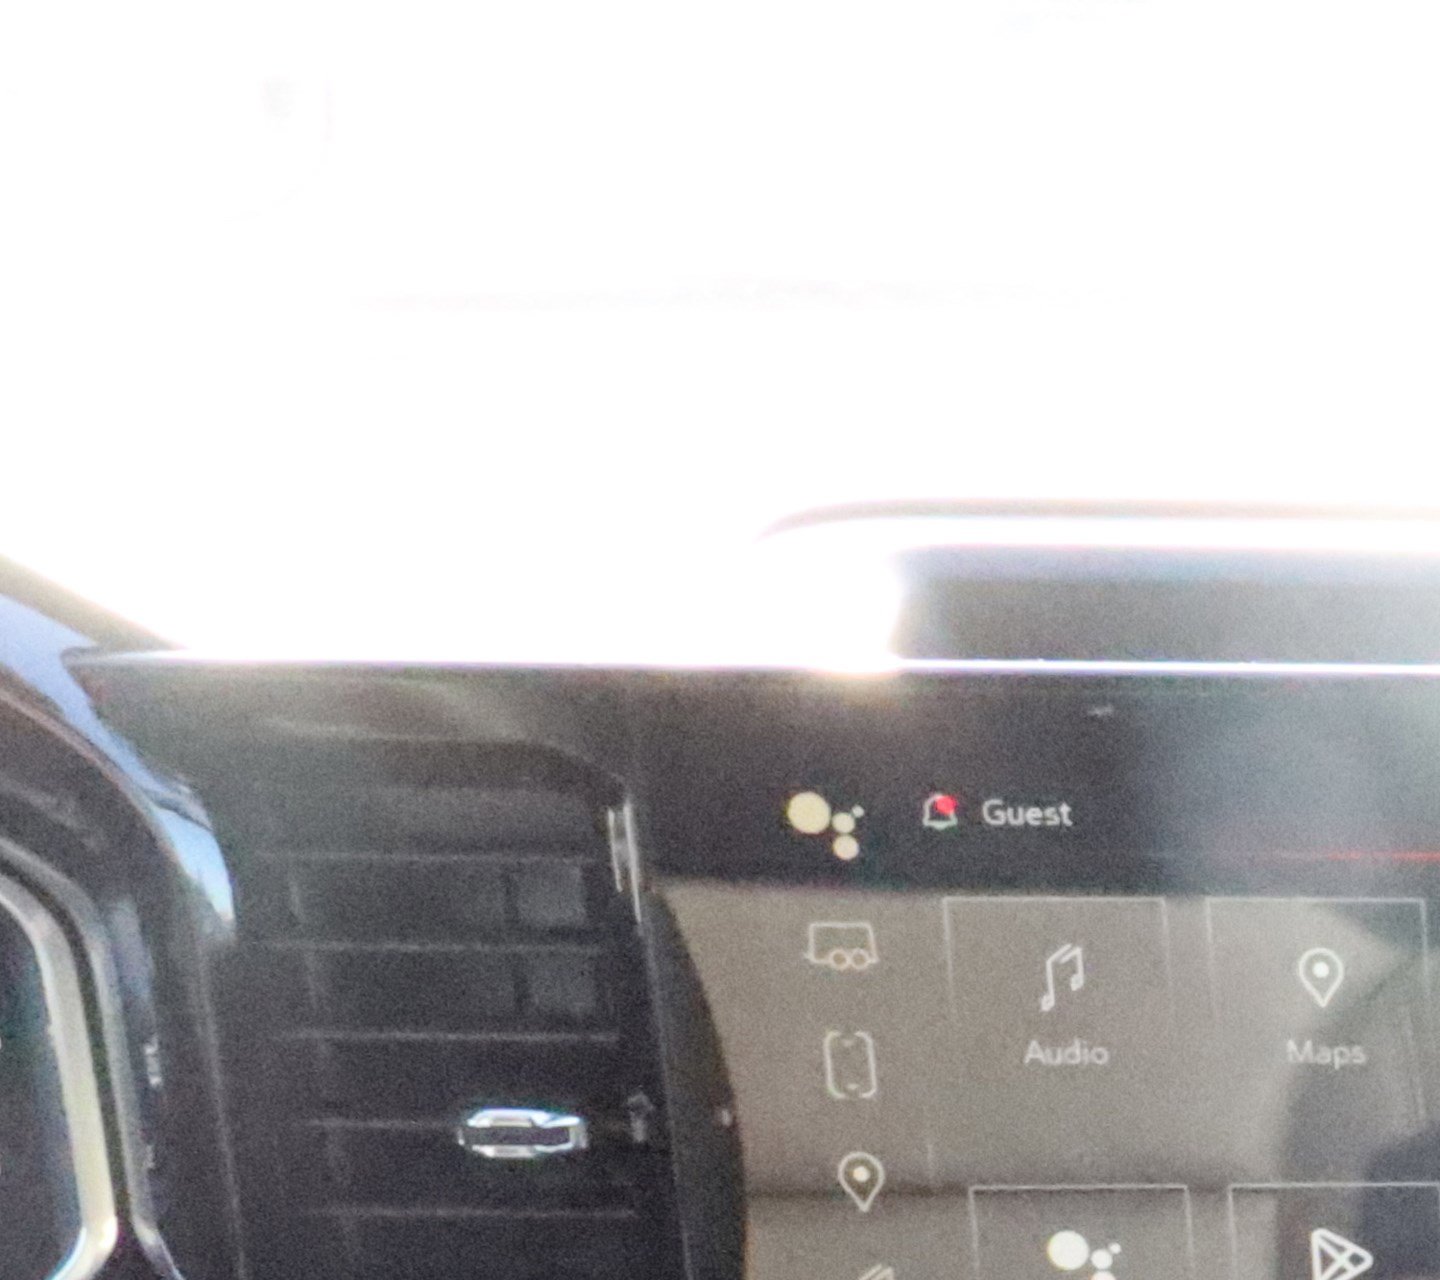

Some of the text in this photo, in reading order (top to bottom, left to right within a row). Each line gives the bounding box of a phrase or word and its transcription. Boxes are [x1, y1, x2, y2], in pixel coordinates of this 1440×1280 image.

[982, 801, 1073, 827] Guest
[1024, 1038, 1110, 1067] Audio
[1287, 1039, 1366, 1071] Maps
